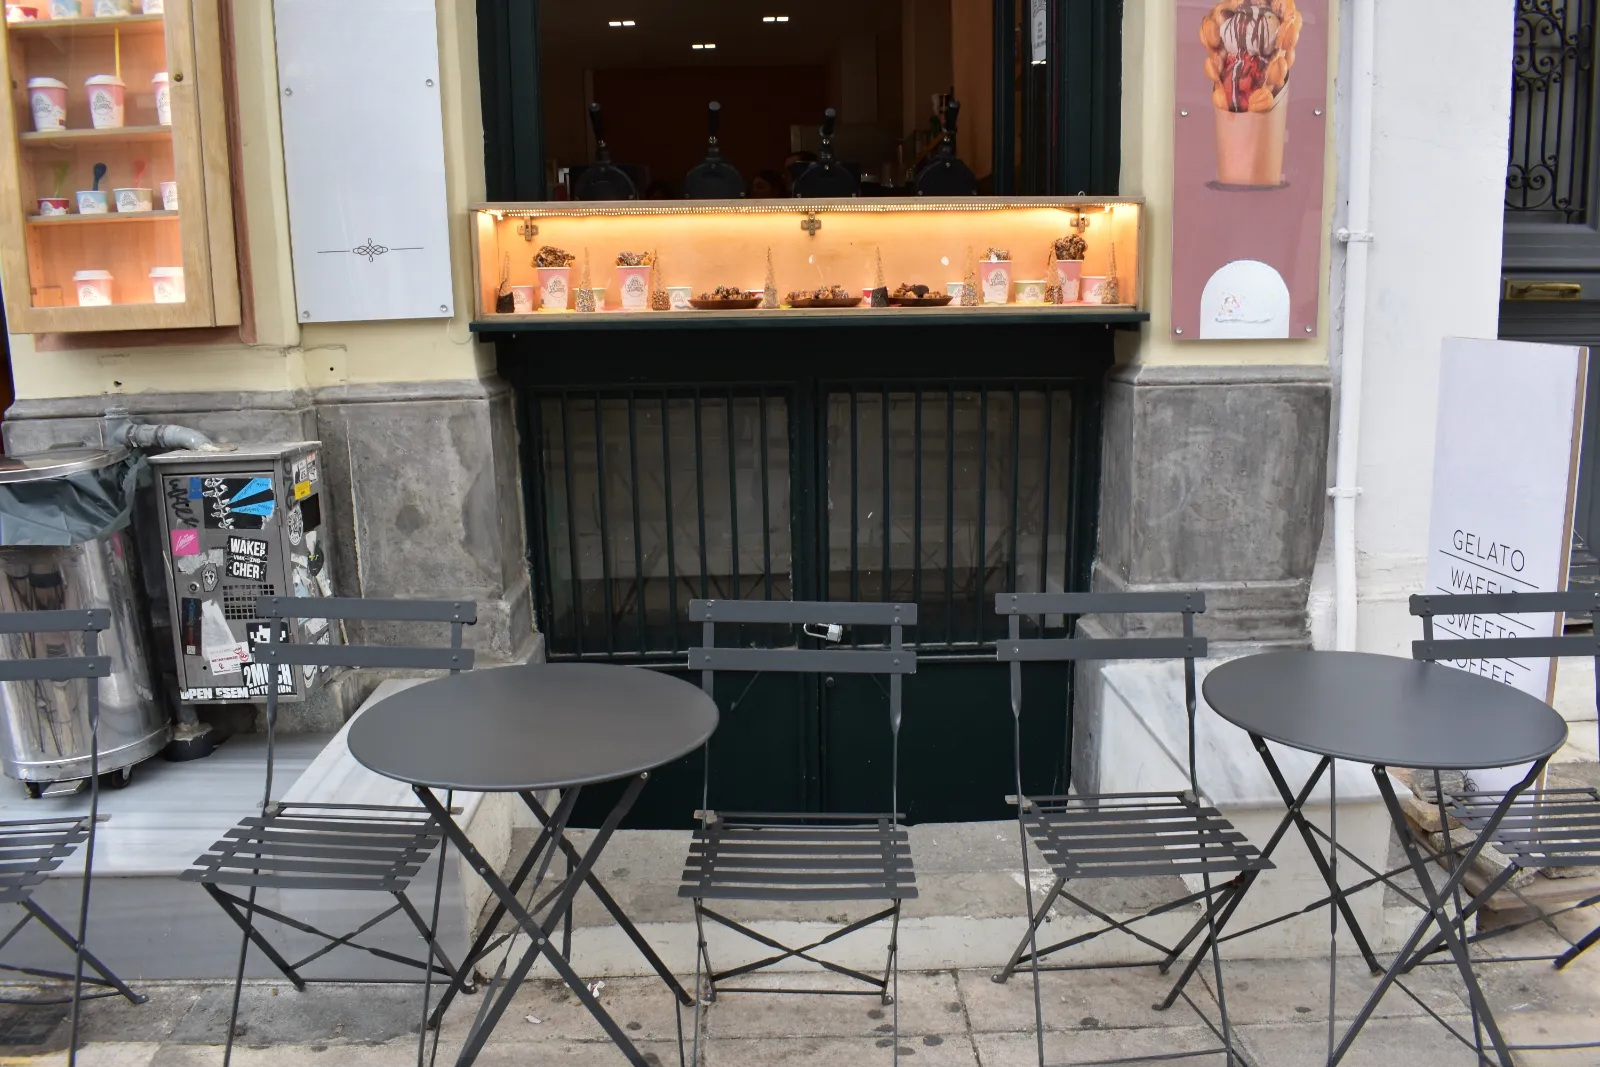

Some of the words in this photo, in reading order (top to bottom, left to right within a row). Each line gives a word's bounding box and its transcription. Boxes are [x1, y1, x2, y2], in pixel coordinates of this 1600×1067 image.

[230, 538, 260, 556] WAKE
[1453, 529, 1525, 572] GELATO
[232, 561, 260, 579] CHER
[1451, 565, 1520, 598] WAFF
[1446, 656, 1515, 685] OFFEE
